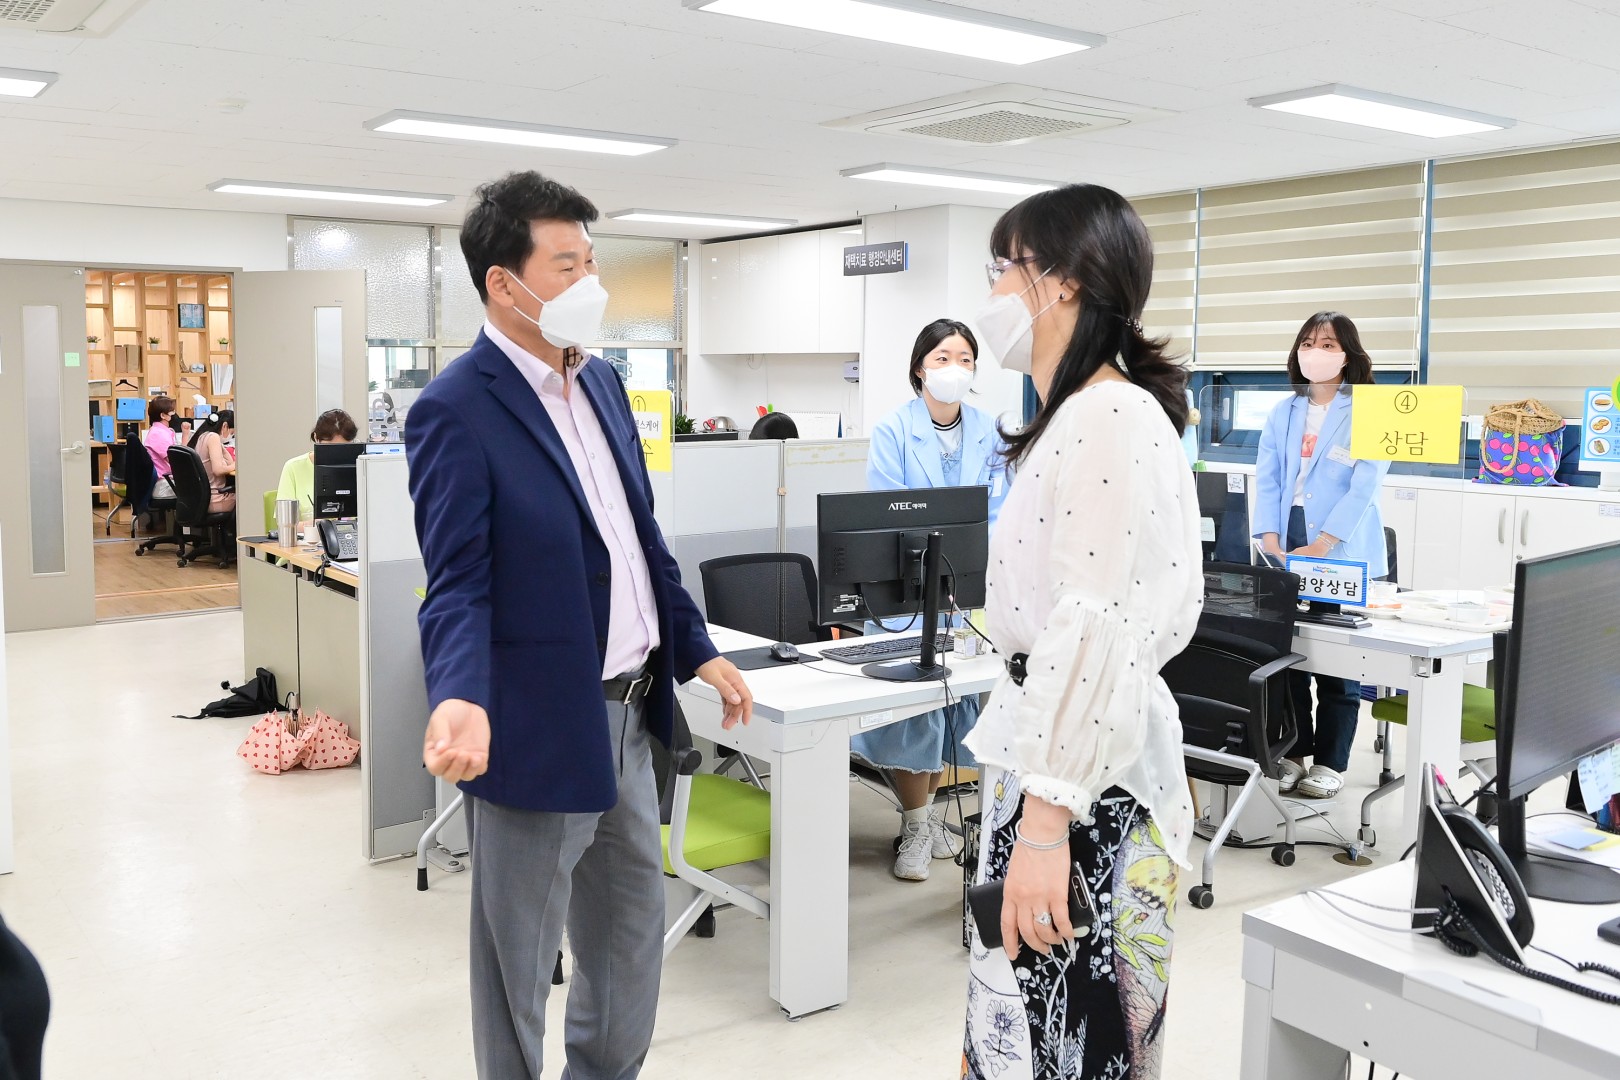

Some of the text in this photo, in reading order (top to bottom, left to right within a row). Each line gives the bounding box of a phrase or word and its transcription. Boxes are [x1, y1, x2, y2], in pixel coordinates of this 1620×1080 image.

[845, 248, 903, 269] 재택치료 행정안내센터
[1379, 430, 1429, 456] 상담
[888, 501, 912, 511] ATEC
